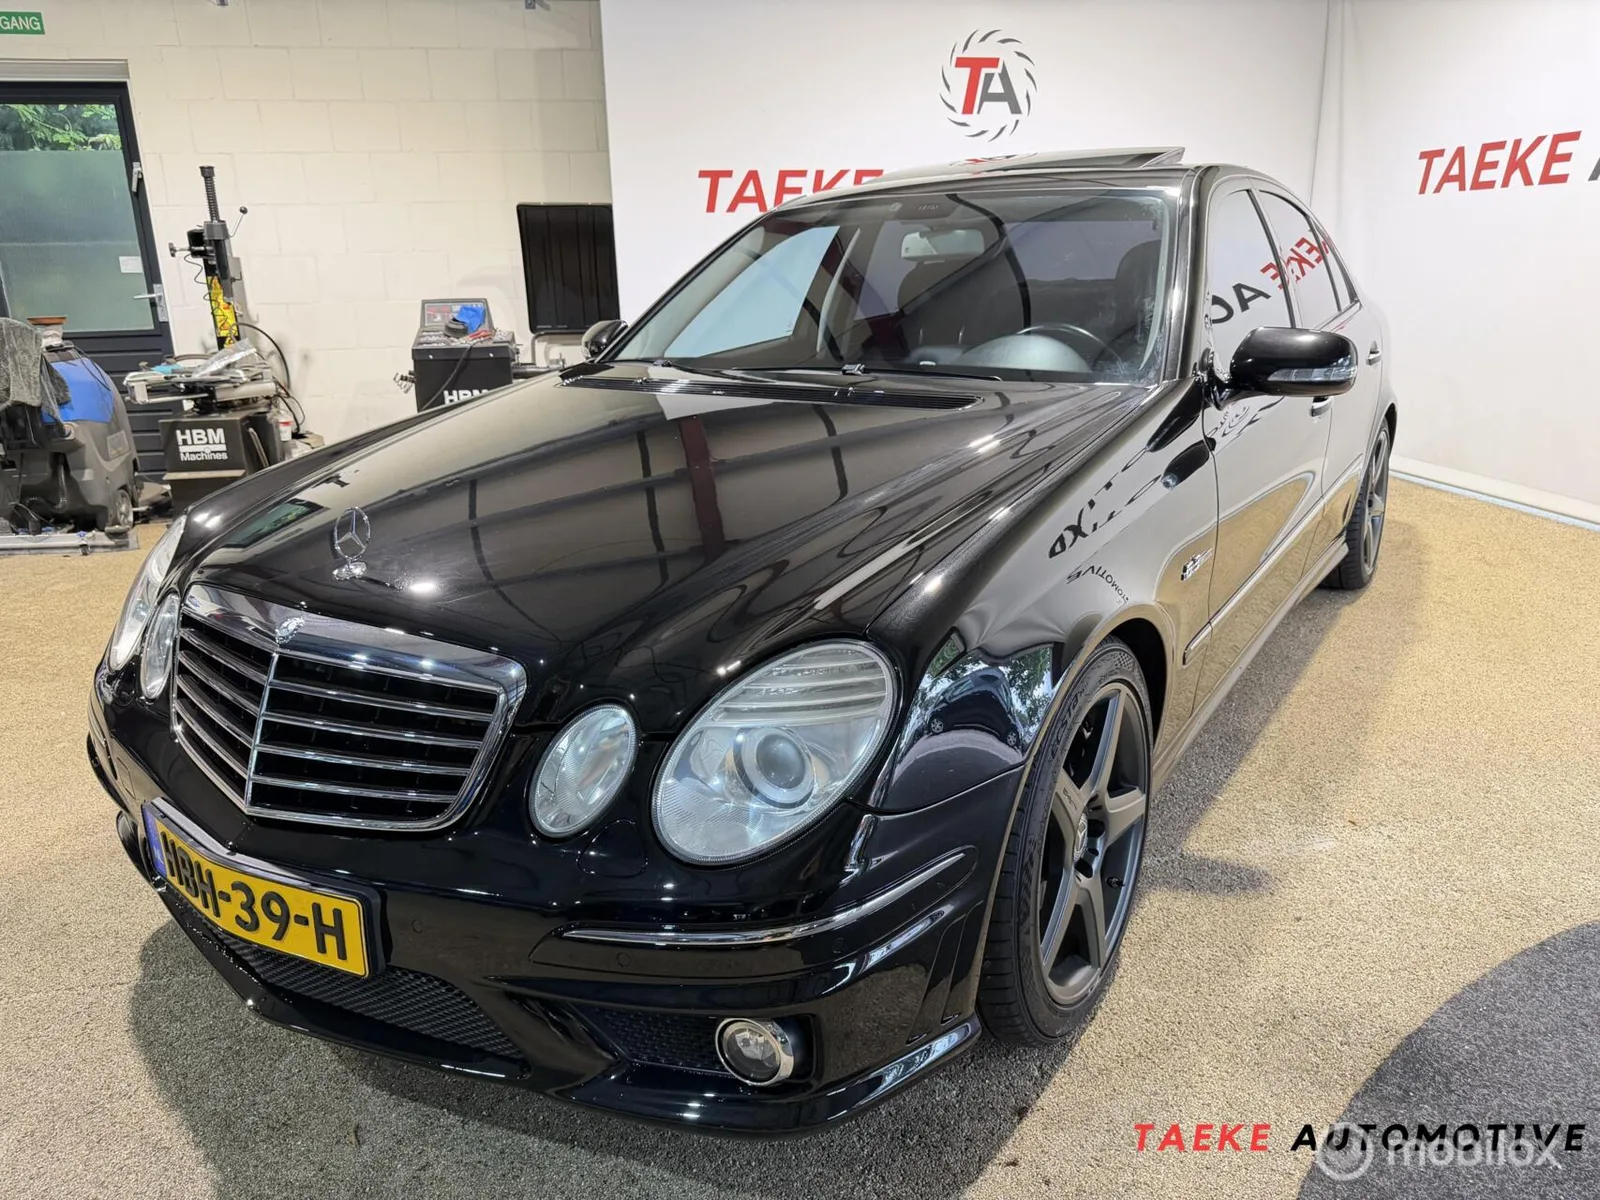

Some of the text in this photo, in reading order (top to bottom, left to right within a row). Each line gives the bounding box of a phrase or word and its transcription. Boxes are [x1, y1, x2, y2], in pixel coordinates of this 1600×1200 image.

[954, 56, 1023, 115] TA
[1418, 130, 1582, 195] TAEKE
[175, 427, 226, 445] HBM
[180, 451, 228, 462] Machines
[160, 831, 348, 961] HBH-39-H
